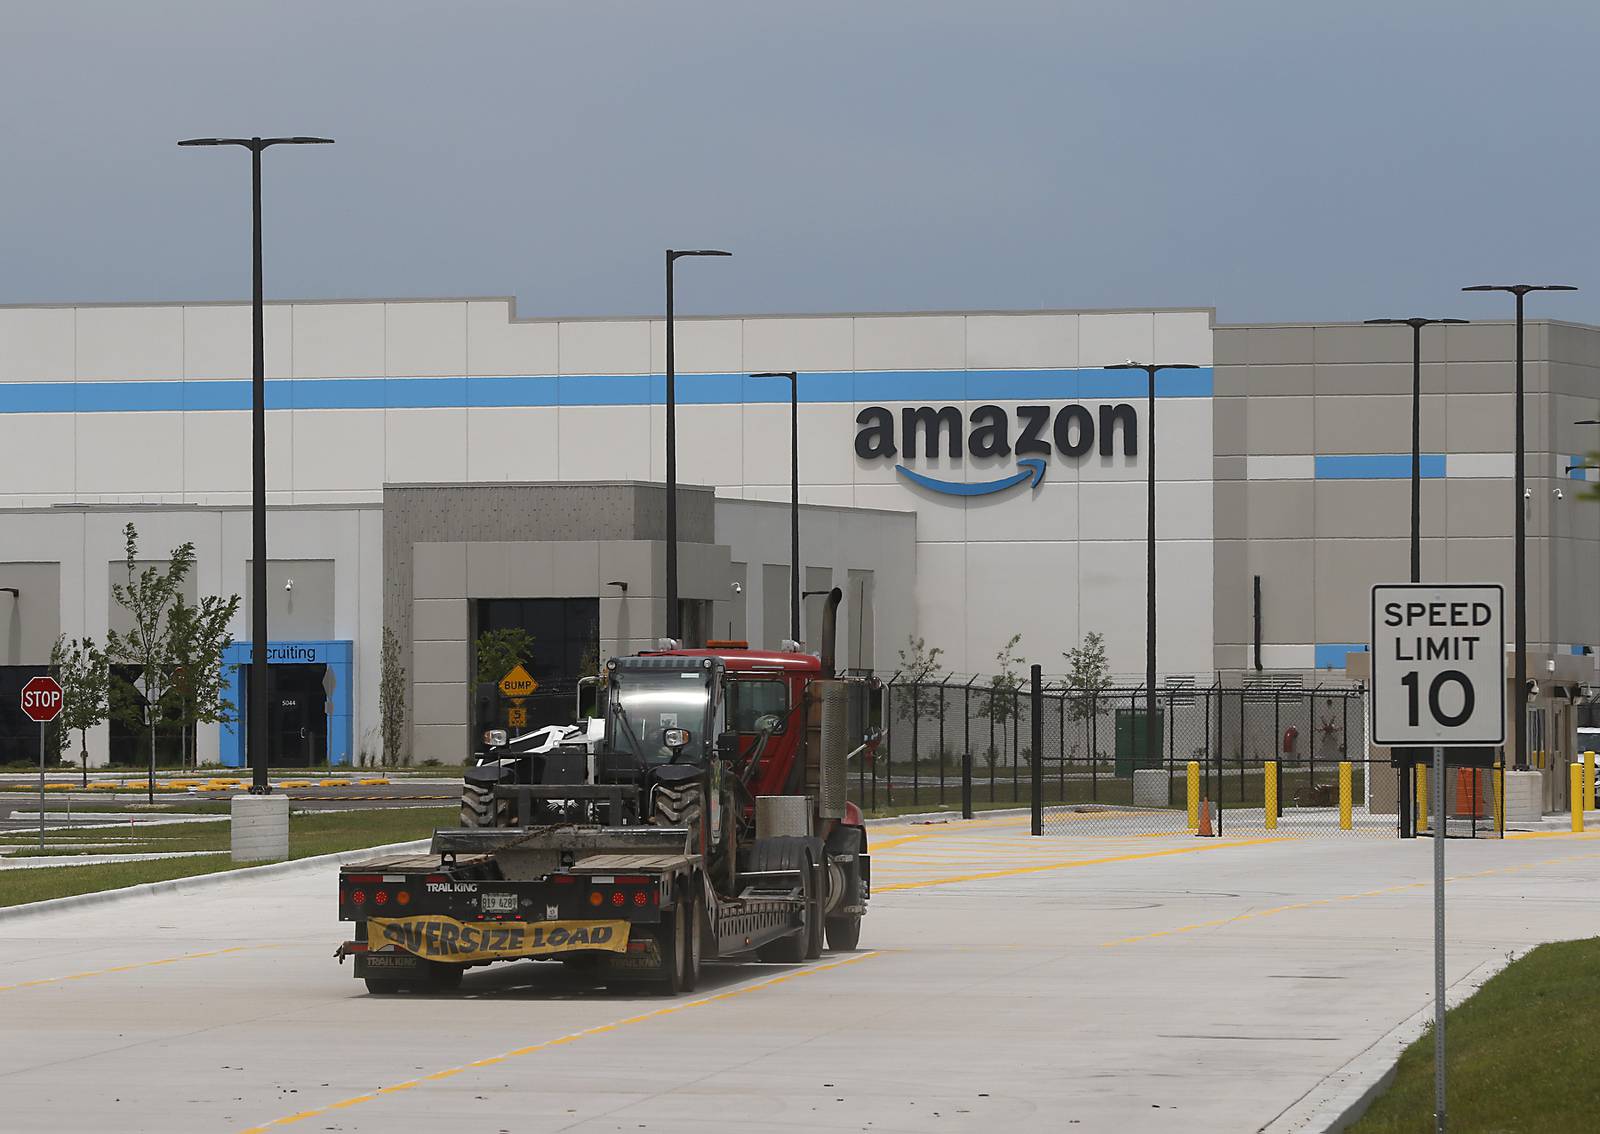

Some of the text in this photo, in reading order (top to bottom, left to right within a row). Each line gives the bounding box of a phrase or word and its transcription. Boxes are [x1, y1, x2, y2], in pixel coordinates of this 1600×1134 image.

[854, 403, 1138, 459] amazon
[1384, 602, 1492, 627] SPEED
[249, 645, 316, 662] rcruiting
[1395, 636, 1481, 661] LIMIT
[504, 681, 532, 690] BUMP
[1401, 669, 1475, 727] 10
[24, 690, 60, 707] STOP
[383, 921, 613, 956] OVERSIZE LOAD
